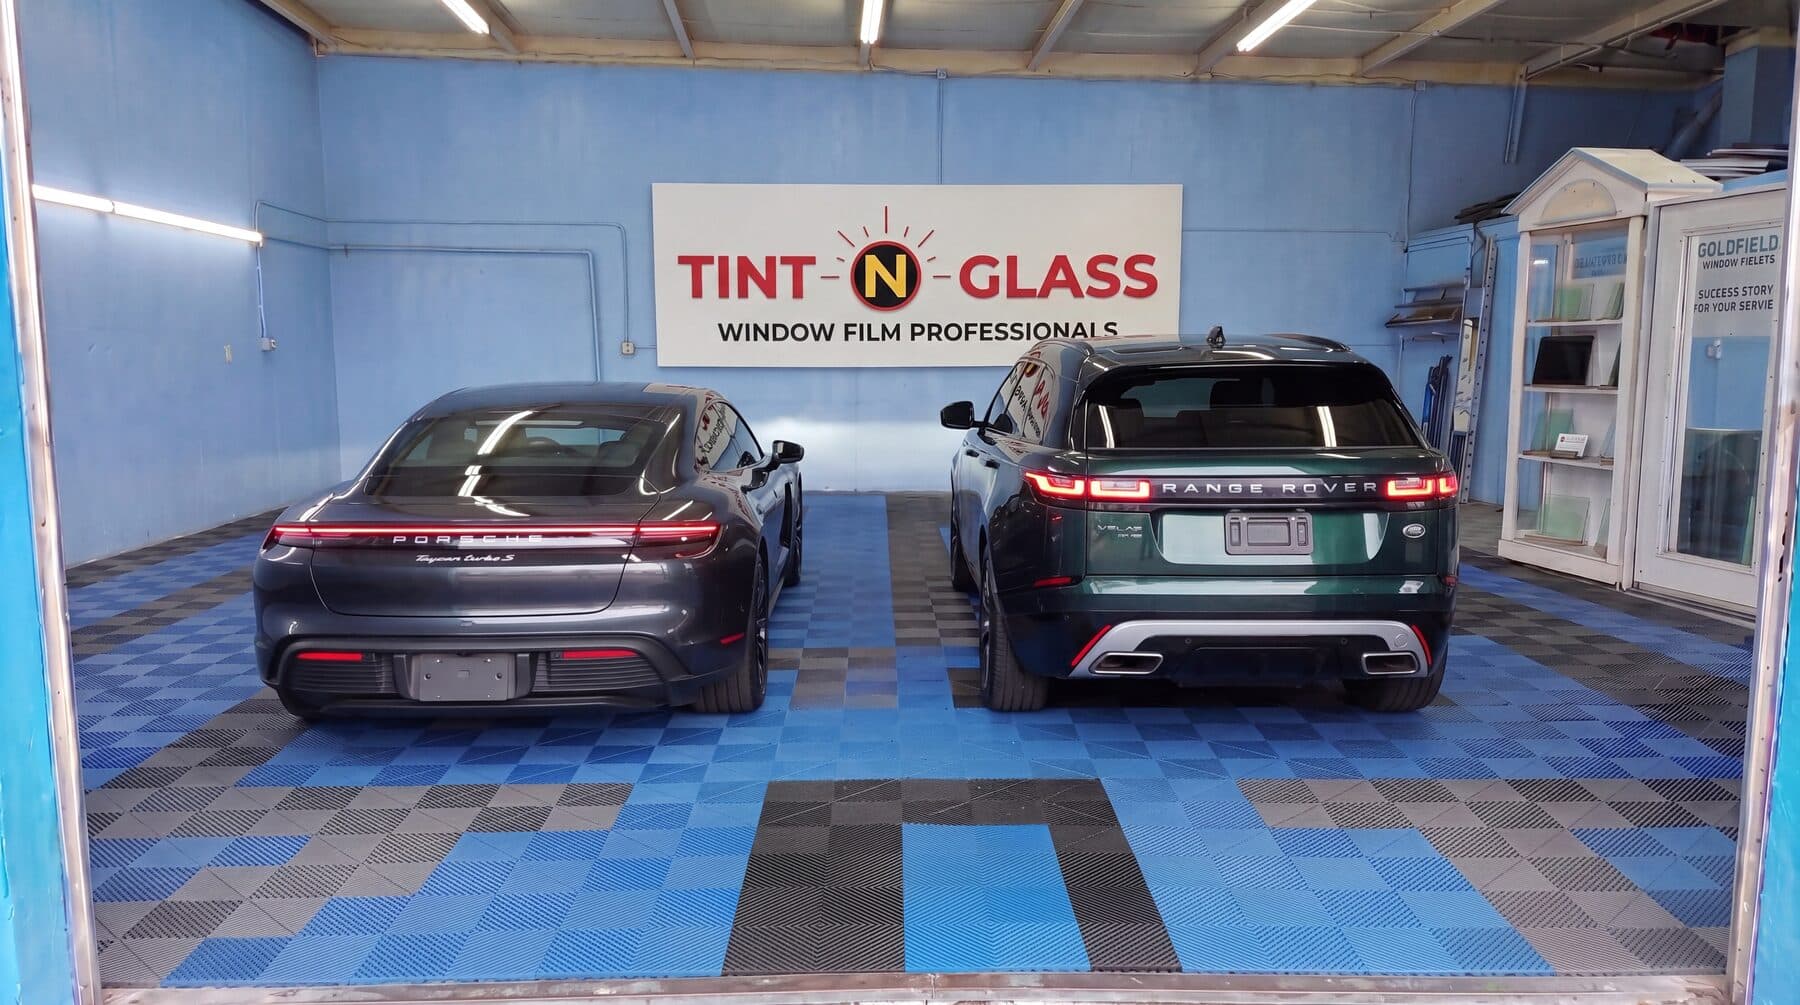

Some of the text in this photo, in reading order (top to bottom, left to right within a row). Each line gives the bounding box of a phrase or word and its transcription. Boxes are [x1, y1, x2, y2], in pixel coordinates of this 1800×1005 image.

[1698, 235, 1779, 258] GOLDFIELD
[1703, 254, 1776, 269] WINDOW FIELETS
[678, 254, 1159, 299] TINT N GLASS
[1698, 284, 1774, 299] SUCEESS STORY
[1694, 299, 1774, 313] FOR YOUR SERVIE
[717, 321, 1118, 342] WINDOW FILM PROFESSIONALS
[1162, 482, 1377, 493] RANGE ROVER
[393, 535, 543, 544] PORSCHE
[416, 555, 461, 564] Taycan
[501, 554, 515, 562] S
